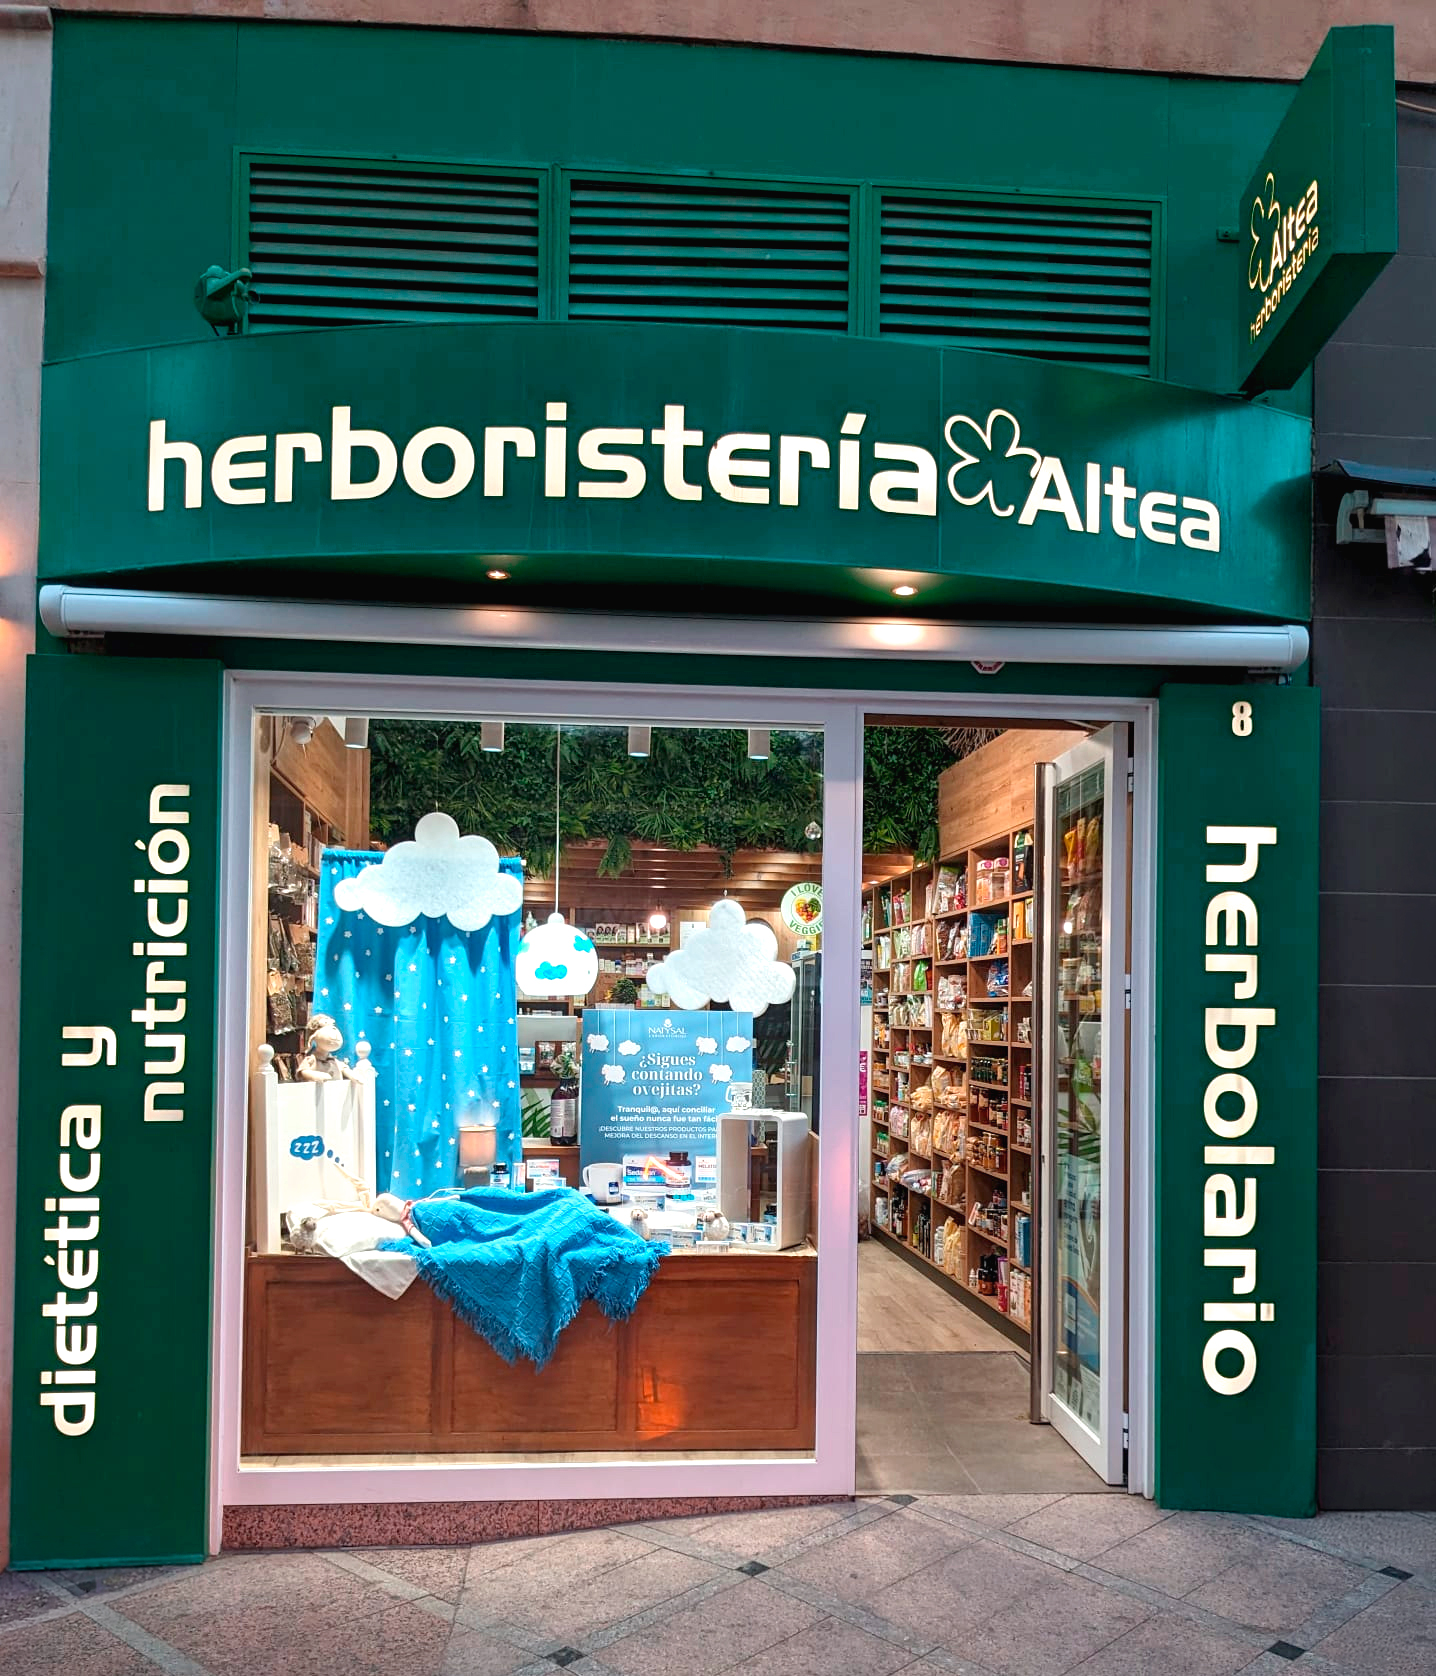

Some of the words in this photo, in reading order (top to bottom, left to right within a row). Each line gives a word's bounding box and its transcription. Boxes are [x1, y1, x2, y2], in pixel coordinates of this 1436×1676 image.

[1268, 180, 1319, 286] Altea
[147, 401, 938, 517] herboristería
[1017, 455, 1221, 554] Altea
[1231, 701, 1254, 738] 8
[131, 783, 191, 1122] nutrición
[61, 1025, 118, 1068] y
[648, 1026, 688, 1035] NATYSAL
[631, 1068, 703, 1081] contando
[639, 1052, 696, 1069] ¿Sigues
[632, 1082, 701, 1099] ovejitas?
[681, 1105, 715, 1113] conciliar
[610, 1114, 618, 1122] el
[619, 1114, 645, 1122] sueño
[673, 1114, 688, 1122] fue
[1202, 825, 1278, 1397] herbolario
[40, 1104, 103, 1437] dietética
